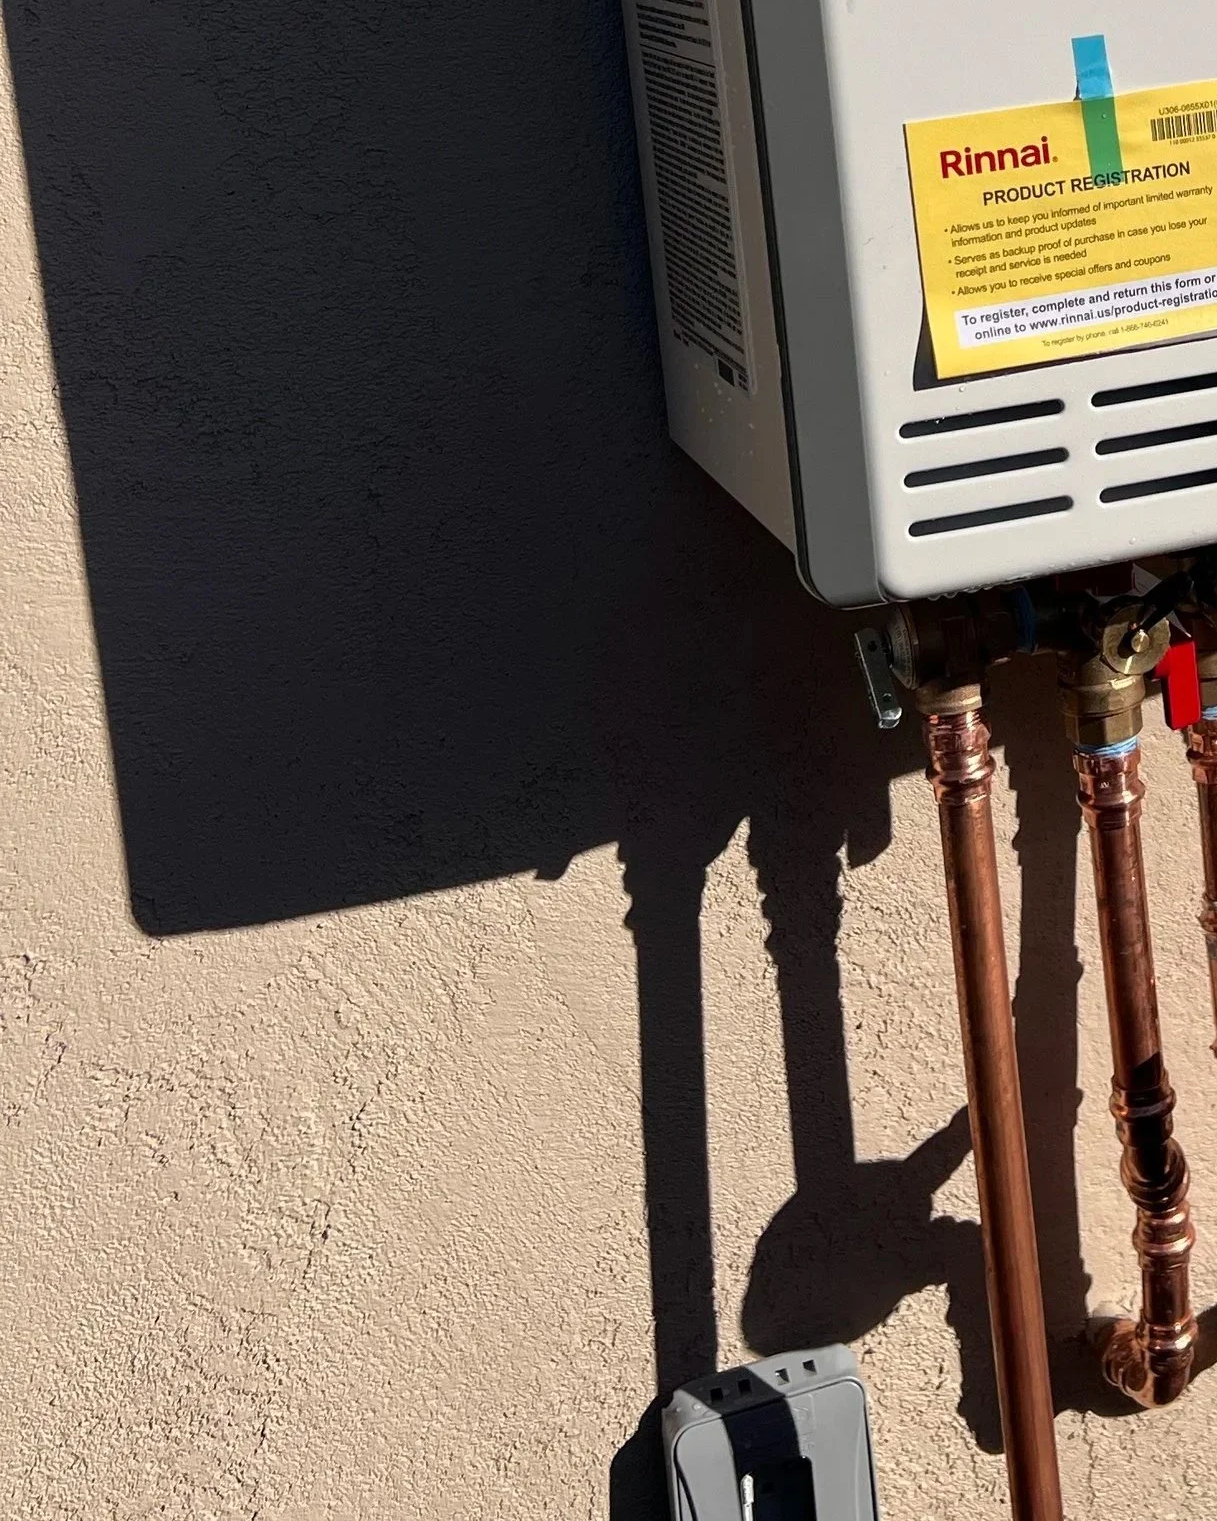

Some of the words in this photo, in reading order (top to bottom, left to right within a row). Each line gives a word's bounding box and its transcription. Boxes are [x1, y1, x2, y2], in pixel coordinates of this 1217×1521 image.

[982, 179, 1066, 206] PRODUCT
[1070, 160, 1190, 193] REGISTRATION
[949, 222, 981, 234] Allows
[982, 220, 994, 229] us
[995, 218, 1005, 227] to
[1006, 214, 1030, 225] keep
[1031, 212, 1049, 224] you
[1050, 203, 1090, 218] informed
[1092, 201, 1101, 212] of
[1102, 195, 1144, 211] important
[1145, 190, 1174, 203] limited
[1175, 185, 1213, 198] warranty
[951, 232, 1003, 247] information
[1004, 227, 1022, 239] and
[1024, 222, 1059, 238] product
[1060, 217, 1096, 231] updates
[954, 253, 987, 265] Serves
[989, 250, 1001, 260] as
[1002, 245, 1036, 257] backup
[1037, 238, 1061, 254] proof
[1062, 236, 1072, 247] of
[1074, 232, 1115, 248] purchase
[1116, 229, 1125, 238] in
[1127, 226, 1148, 237] case
[1149, 224, 1166, 236] you
[1167, 220, 1186, 230] lose
[1188, 216, 1207, 229] your
[955, 264, 988, 278] receipt
[989, 261, 1007, 273] and
[1008, 257, 1041, 270] service
[1042, 254, 1051, 264] is
[1053, 248, 1087, 262] needed
[956, 284, 987, 296] Allows
[988, 281, 1006, 293] you
[1008, 278, 1018, 288] to
[1019, 273, 1052, 285] receive
[1054, 266, 1086, 281] special
[1087, 263, 1113, 274] offers
[1114, 258, 1131, 270] and
[1133, 253, 1171, 267] coupons
[961, 314, 977, 325] To
[980, 307, 1028, 323] register,
[1031, 296, 1085, 314] complete
[1088, 290, 1110, 304] and
[1113, 286, 1148, 300] return
[1150, 280, 1172, 293] this
[1174, 277, 1201, 289] form
[1203, 274, 1216, 284] or
[974, 326, 1011, 340] online
[1014, 323, 1026, 333] to
[1075, 334, 1084, 342] by
